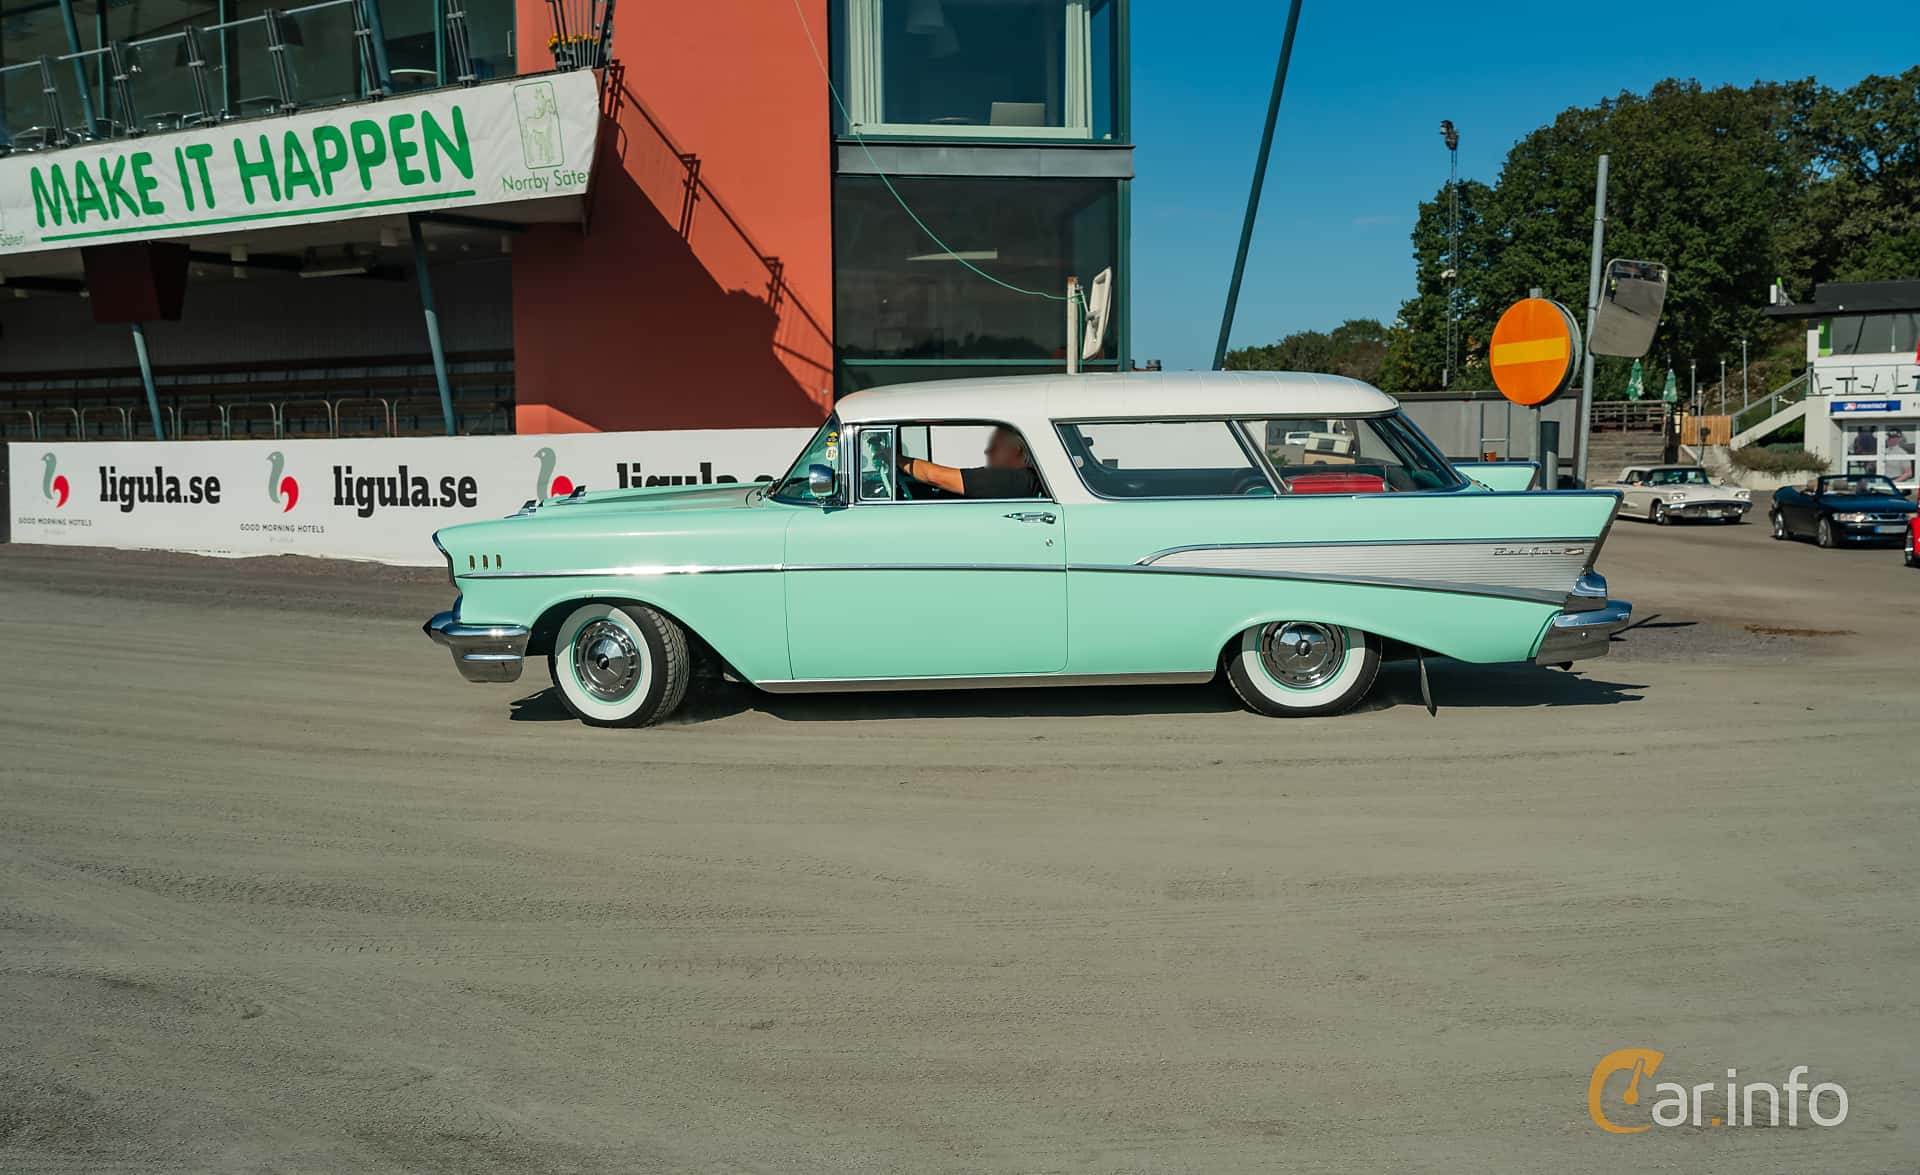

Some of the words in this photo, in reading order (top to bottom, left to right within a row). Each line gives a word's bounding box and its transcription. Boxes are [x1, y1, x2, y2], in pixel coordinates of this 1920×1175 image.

[31, 144, 166, 228] MAKE
[174, 144, 217, 212] IT
[233, 106, 475, 206] HAPPEN
[502, 172, 549, 193] Norrby
[99, 466, 221, 513] ligula.se
[333, 464, 478, 519] ligula.se
[240, 523, 260, 531] GOOD
[262, 523, 295, 532] MORNING
[297, 525, 325, 533] HOTELS
